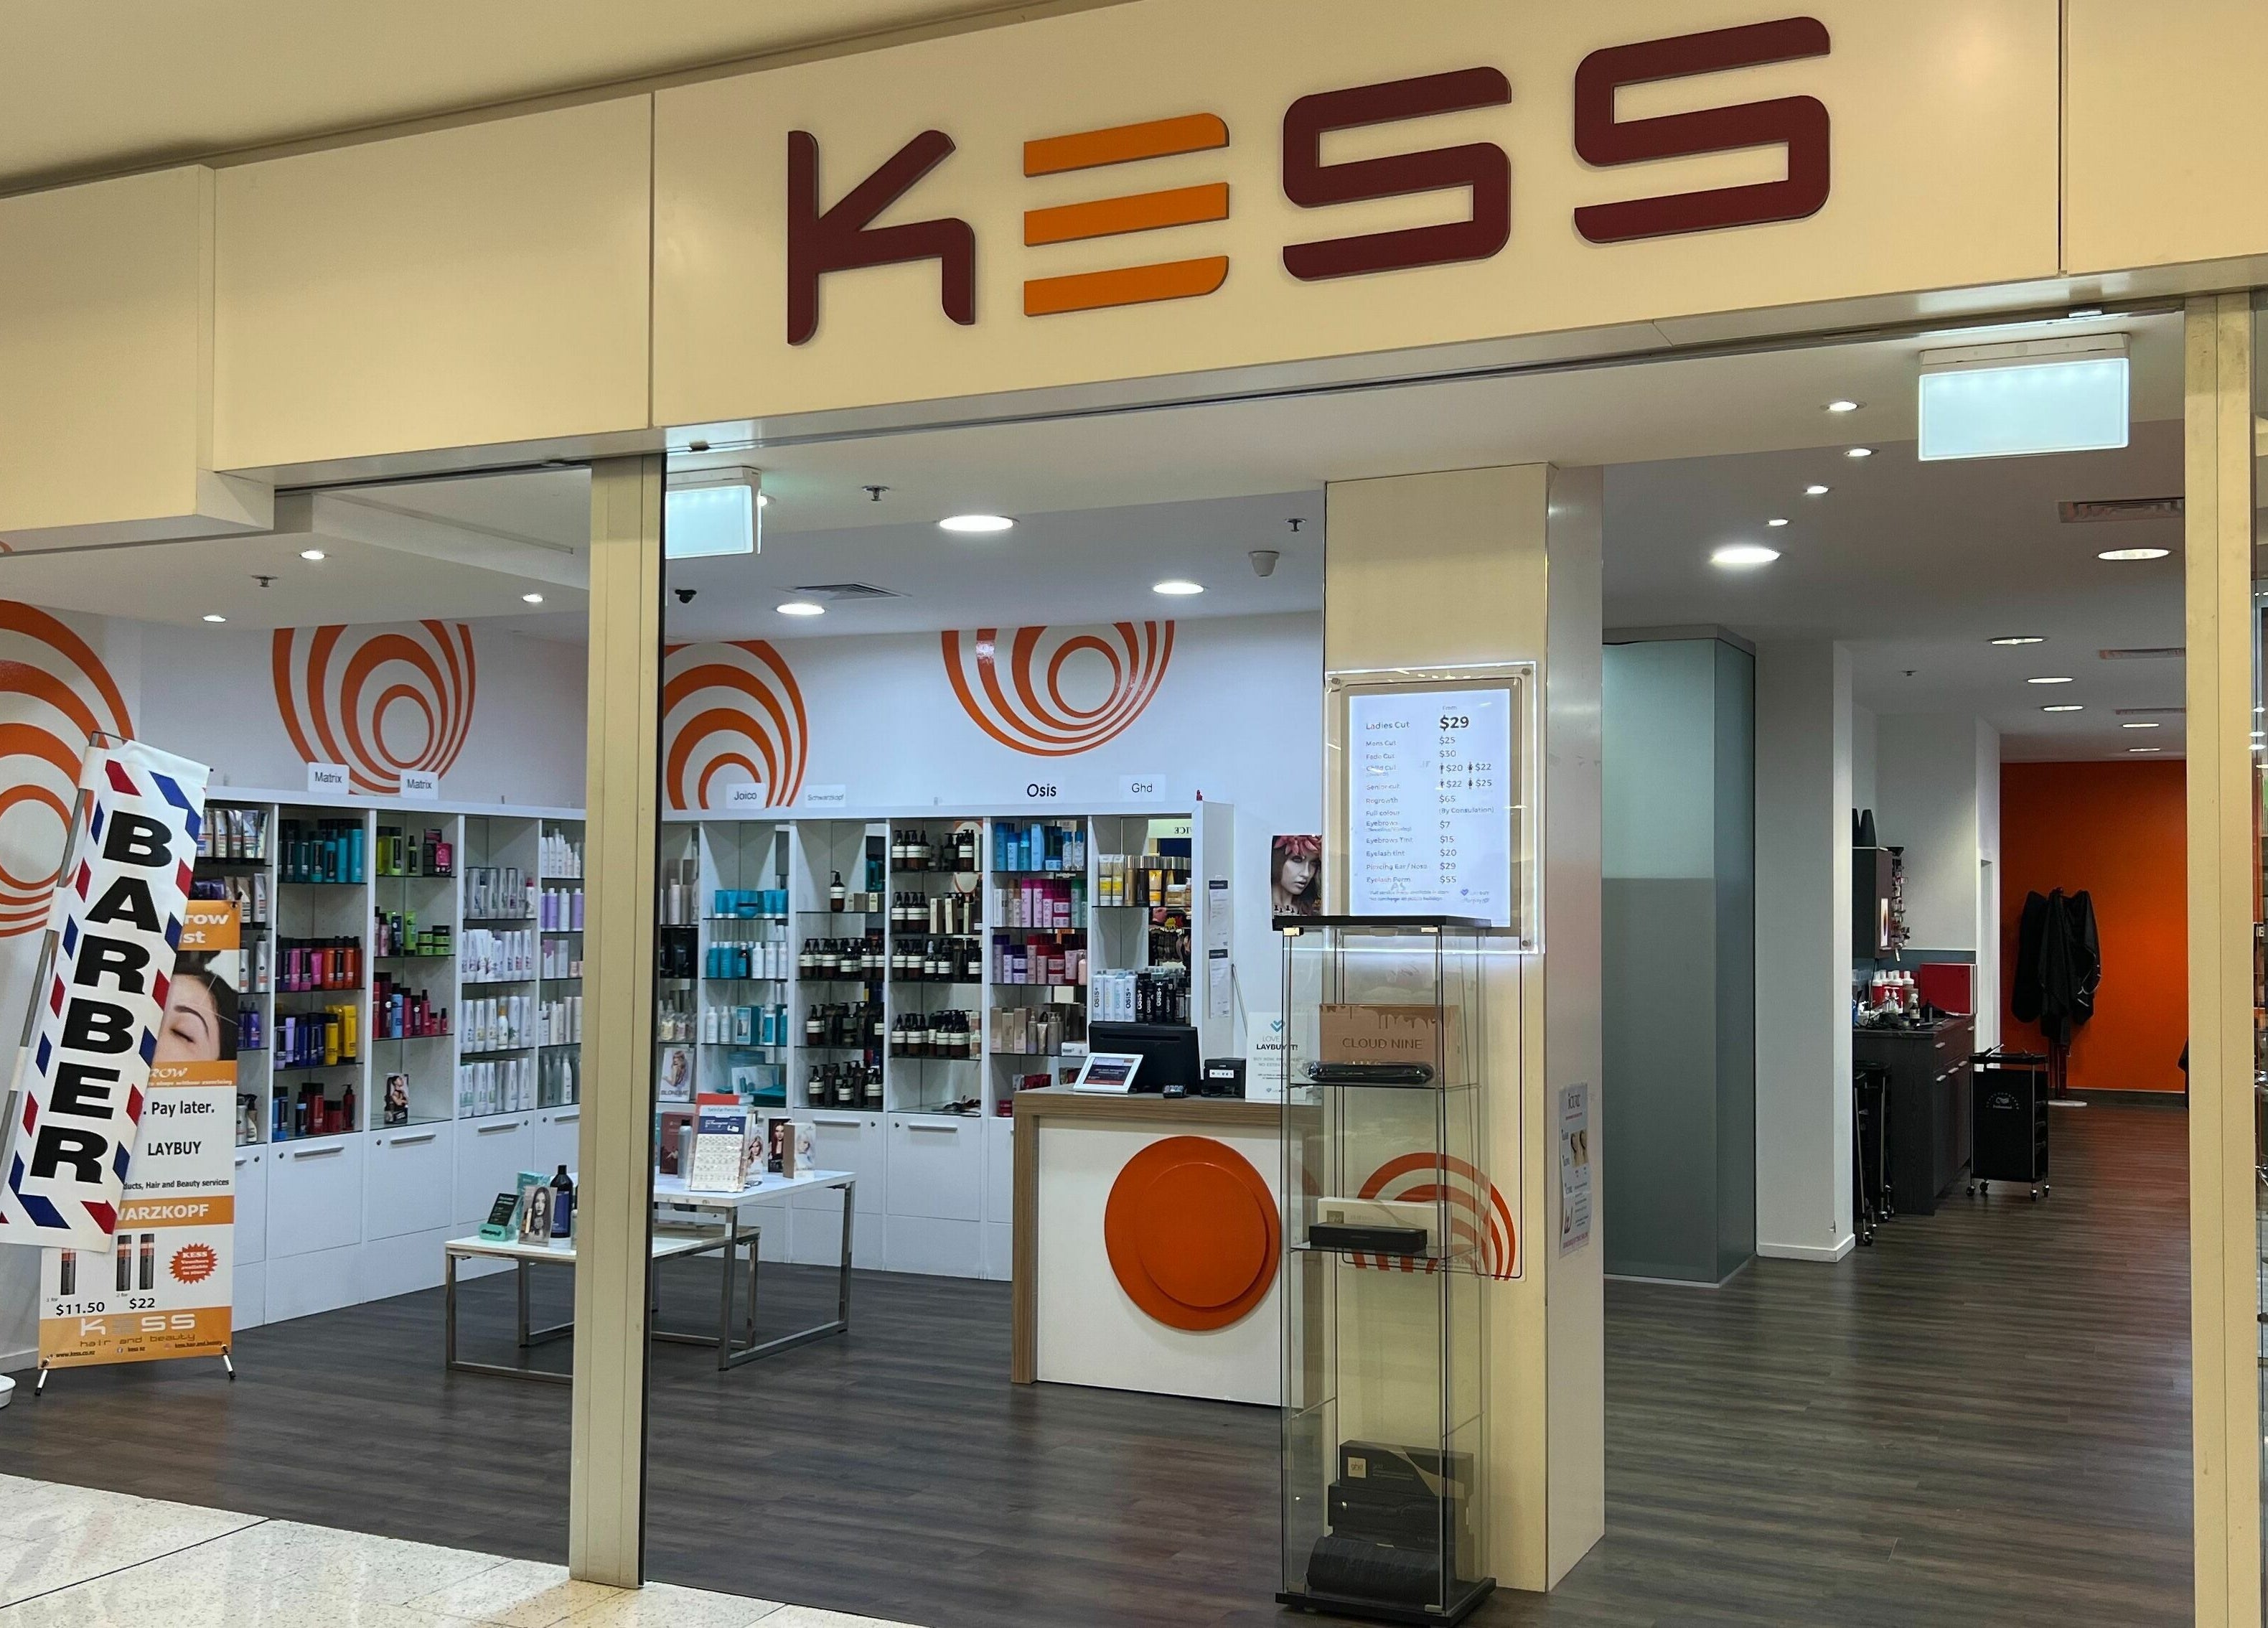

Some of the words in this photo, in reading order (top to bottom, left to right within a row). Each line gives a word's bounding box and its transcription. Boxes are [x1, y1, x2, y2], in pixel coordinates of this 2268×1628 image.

[787, 16, 1830, 345] KESS
[1439, 714, 1469, 731] $29
[1439, 736, 1456, 745] $25
[1439, 749, 1456, 758] $30
[1445, 764, 1463, 772] $20
[1475, 763, 1491, 772] $22
[315, 771, 342, 784] Matrix
[407, 777, 432, 790] Matrix
[1446, 780, 1462, 788] $22
[1476, 779, 1492, 787] $25
[1027, 784, 1056, 797] Osis
[1132, 782, 1153, 792] Ghd
[734, 790, 757, 802] Joico
[1439, 794, 1456, 803] $65
[1440, 820, 1451, 830] $7
[1440, 836, 1454, 844] $15
[1440, 848, 1457, 858] $20
[1440, 862, 1456, 871] $29
[1440, 875, 1457, 884] $55
[184, 913, 229, 925] row
[29, 810, 172, 1186] BARBER
[1342, 1037, 1387, 1049] CLOUD
[1391, 1039, 1423, 1049] NINE
[150, 1067, 187, 1078] ROW
[151, 1102, 176, 1118] Pay
[180, 1100, 215, 1114] later.
[148, 1141, 202, 1156] LAYBUY
[177, 1180, 200, 1189] Beauty
[56, 1301, 105, 1316] $11.50
[129, 1298, 155, 1310] $22
[80, 1339, 111, 1347] hair
[150, 1333, 195, 1342] beauty
